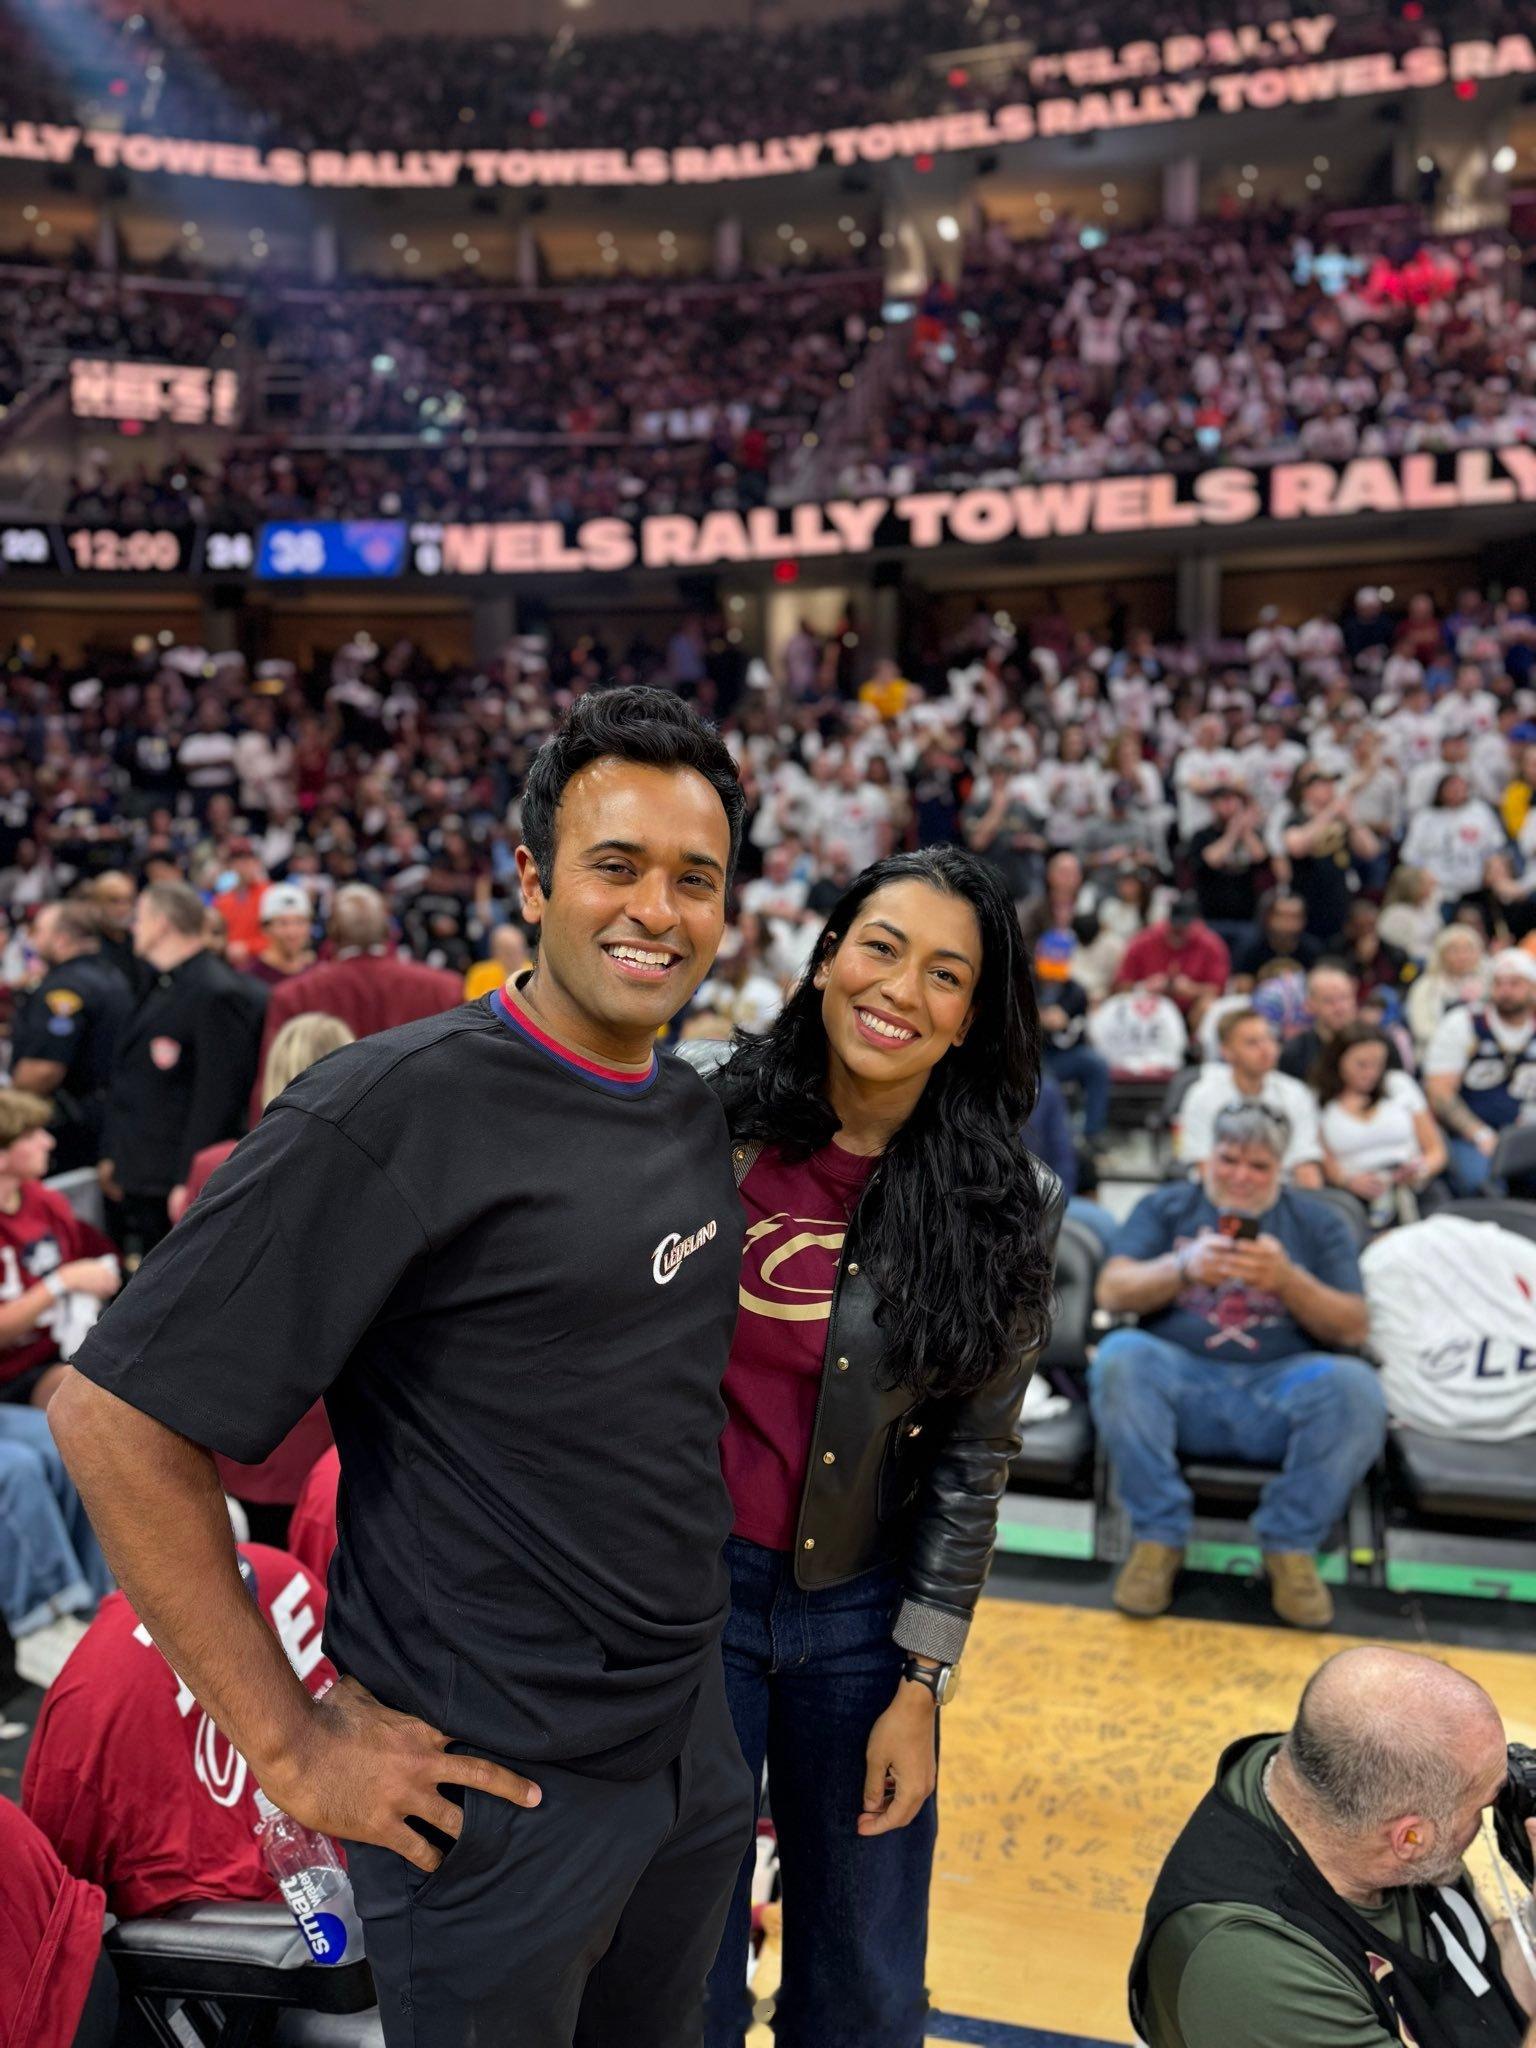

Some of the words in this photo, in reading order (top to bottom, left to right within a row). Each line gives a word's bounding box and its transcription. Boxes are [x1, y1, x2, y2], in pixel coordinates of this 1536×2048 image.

[83, 129, 307, 187] TOWELS
[309, 149, 464, 188] RALLY
[467, 148, 669, 187] TOWELS
[671, 131, 824, 184] RALLY
[825, 102, 1035, 167] TOWELS
[1036, 79, 1206, 138] RALLY
[1208, 45, 1448, 113] TOWELS
[68, 528, 181, 572] 12:00
[640, 497, 890, 569] RALLY
[893, 466, 1261, 548] TOWELS
[650, 1220, 717, 1285] CLEVELAND
[280, 1875, 330, 1955] smart
[297, 1871, 327, 1908] water
